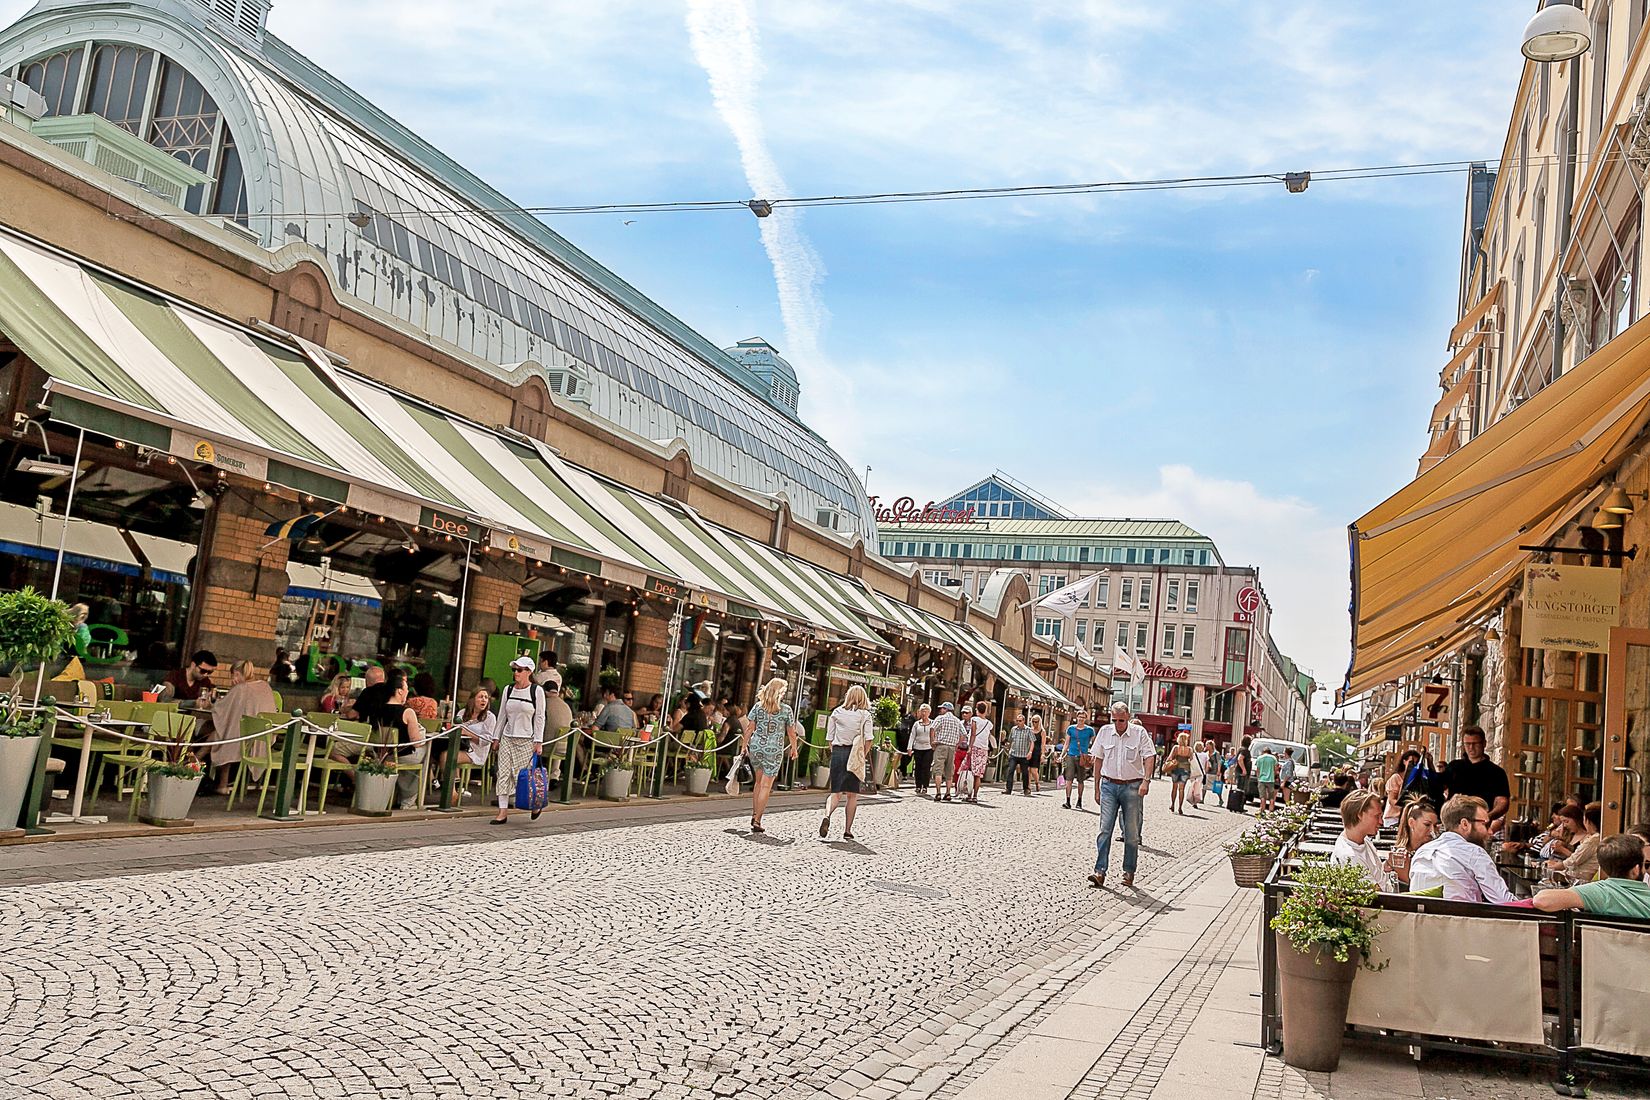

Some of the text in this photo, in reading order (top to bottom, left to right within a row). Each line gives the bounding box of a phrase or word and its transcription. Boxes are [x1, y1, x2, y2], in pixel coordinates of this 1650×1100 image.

[891, 496, 977, 524] Palatset
[432, 512, 469, 536] bee
[654, 579, 677, 597] bee
[1527, 600, 1617, 615] KUNGSTORGET
[1425, 686, 1449, 719] 7
